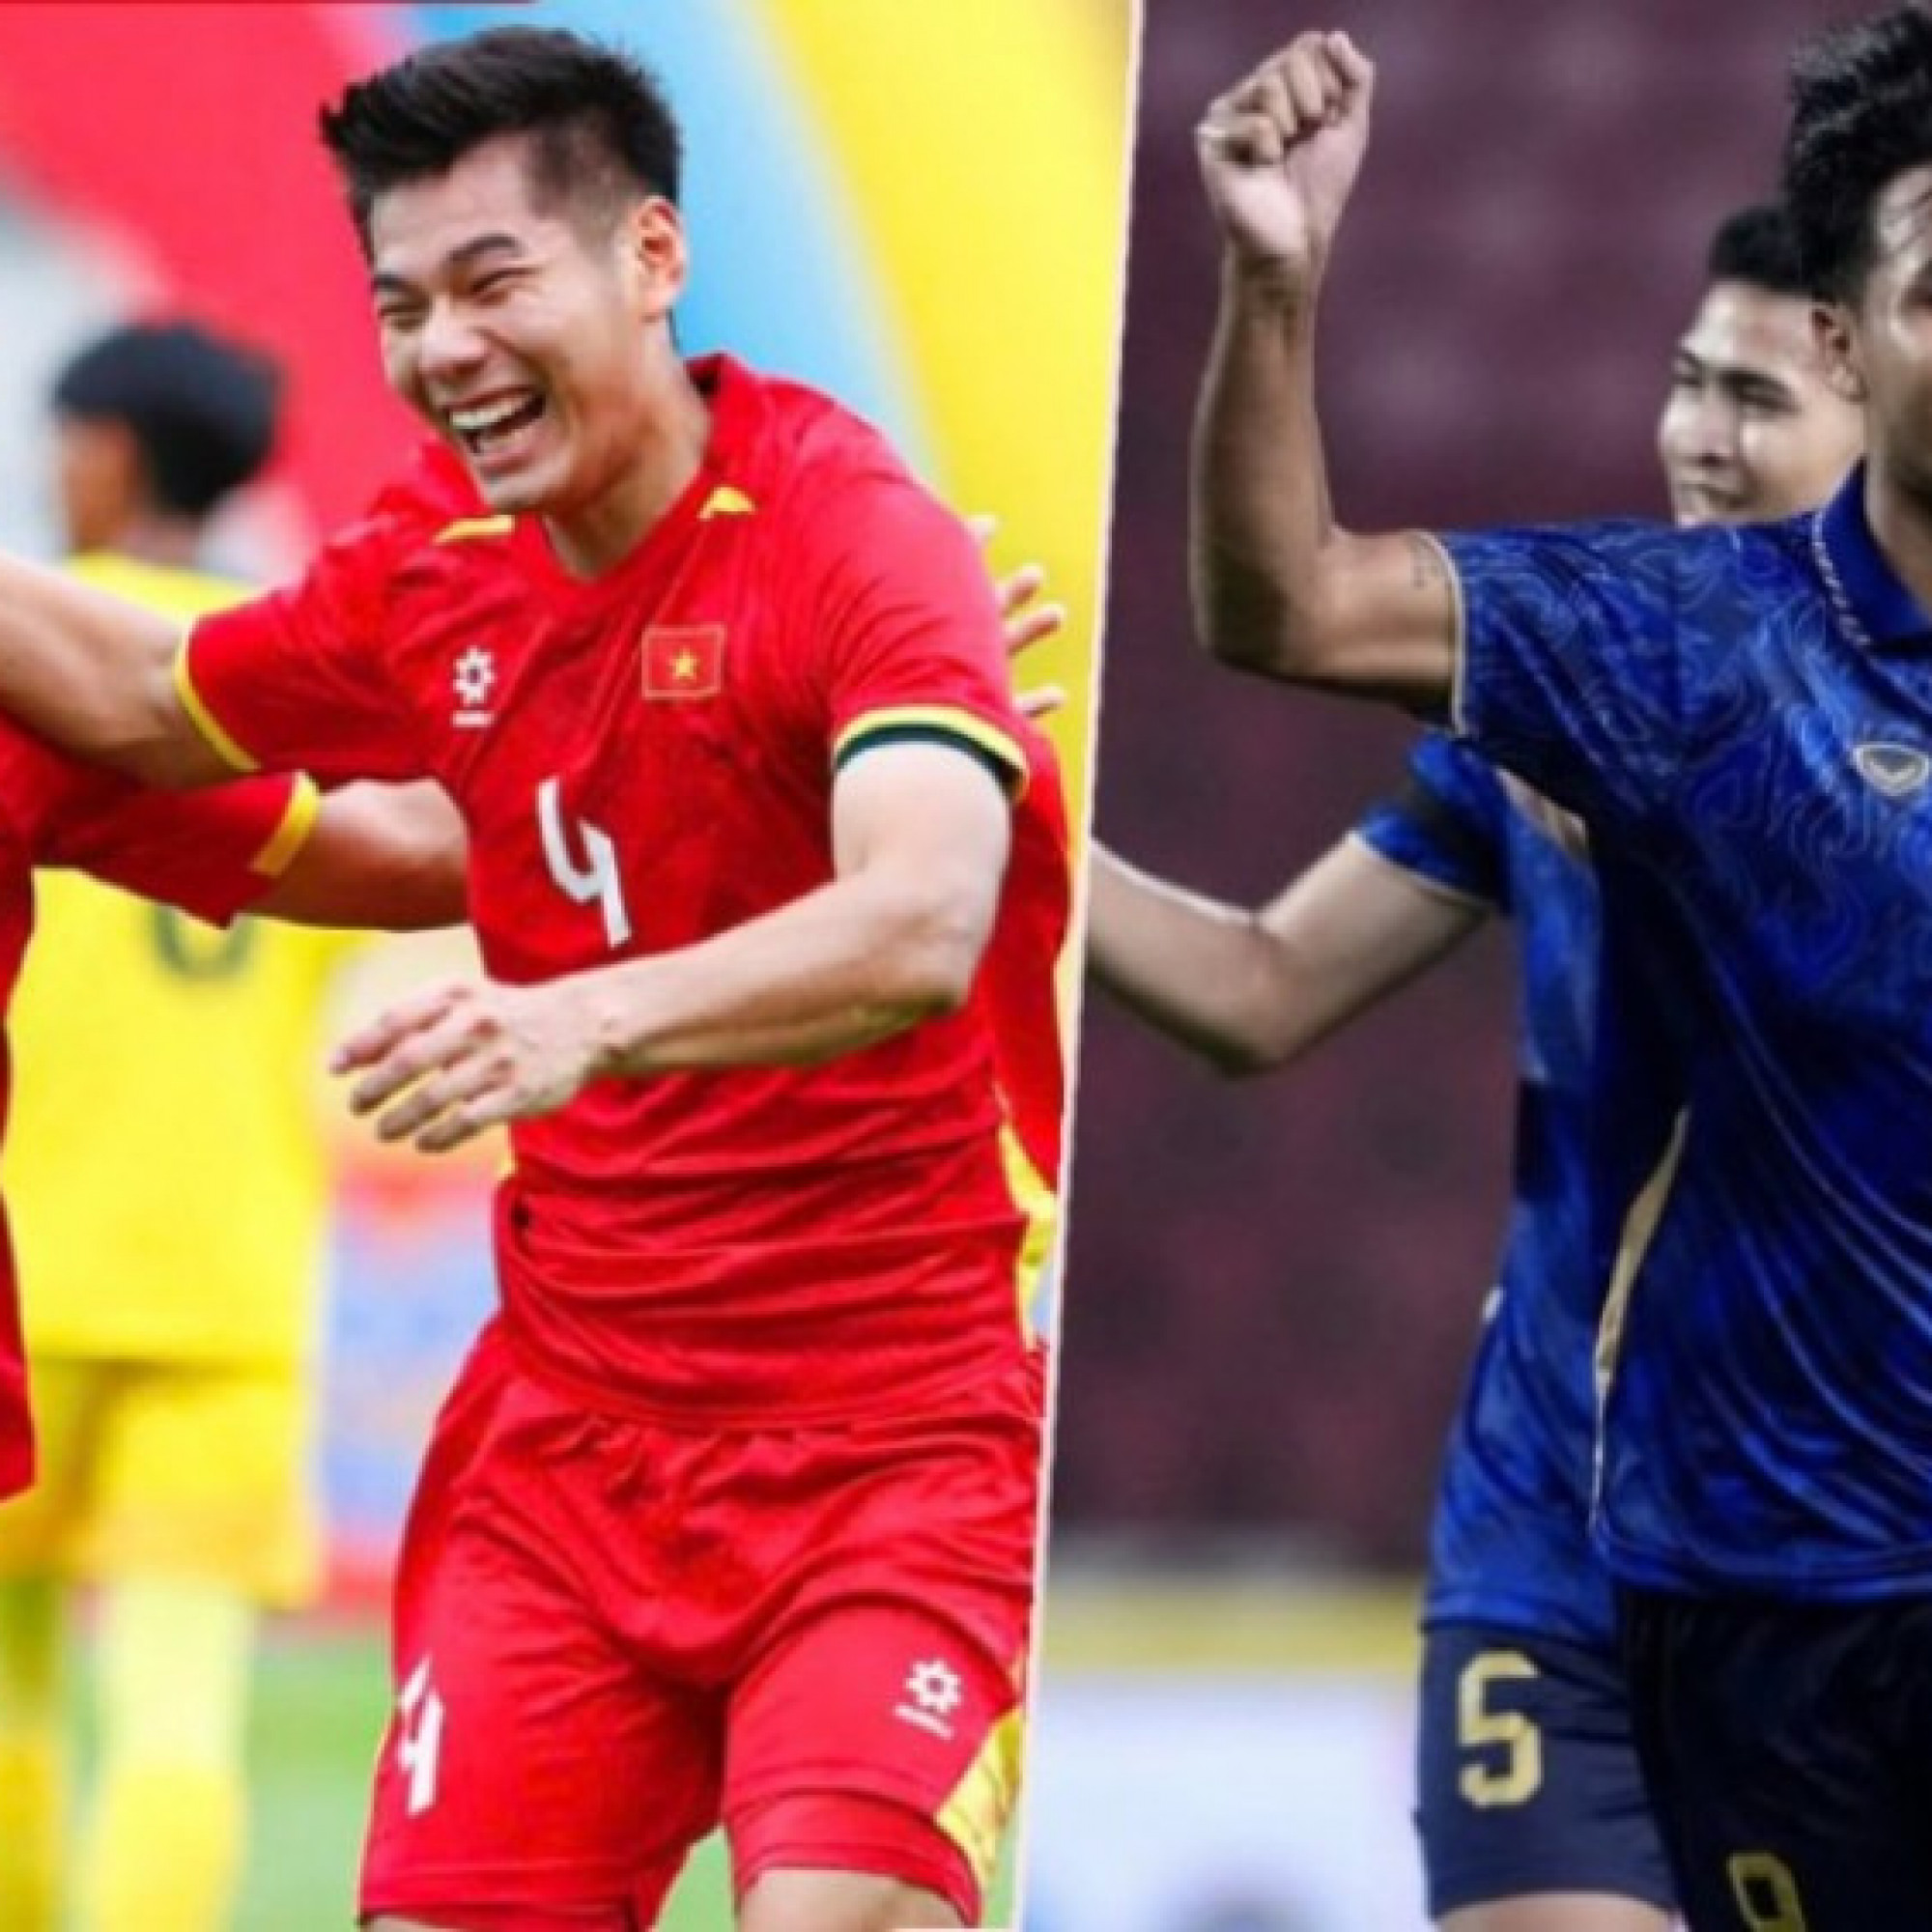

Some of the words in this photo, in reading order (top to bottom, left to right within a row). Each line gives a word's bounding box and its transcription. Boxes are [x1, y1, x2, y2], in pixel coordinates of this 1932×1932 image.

[537, 778, 631, 948] 4
[397, 1655, 442, 1813] 4
[1458, 1650, 1542, 1806] 5
